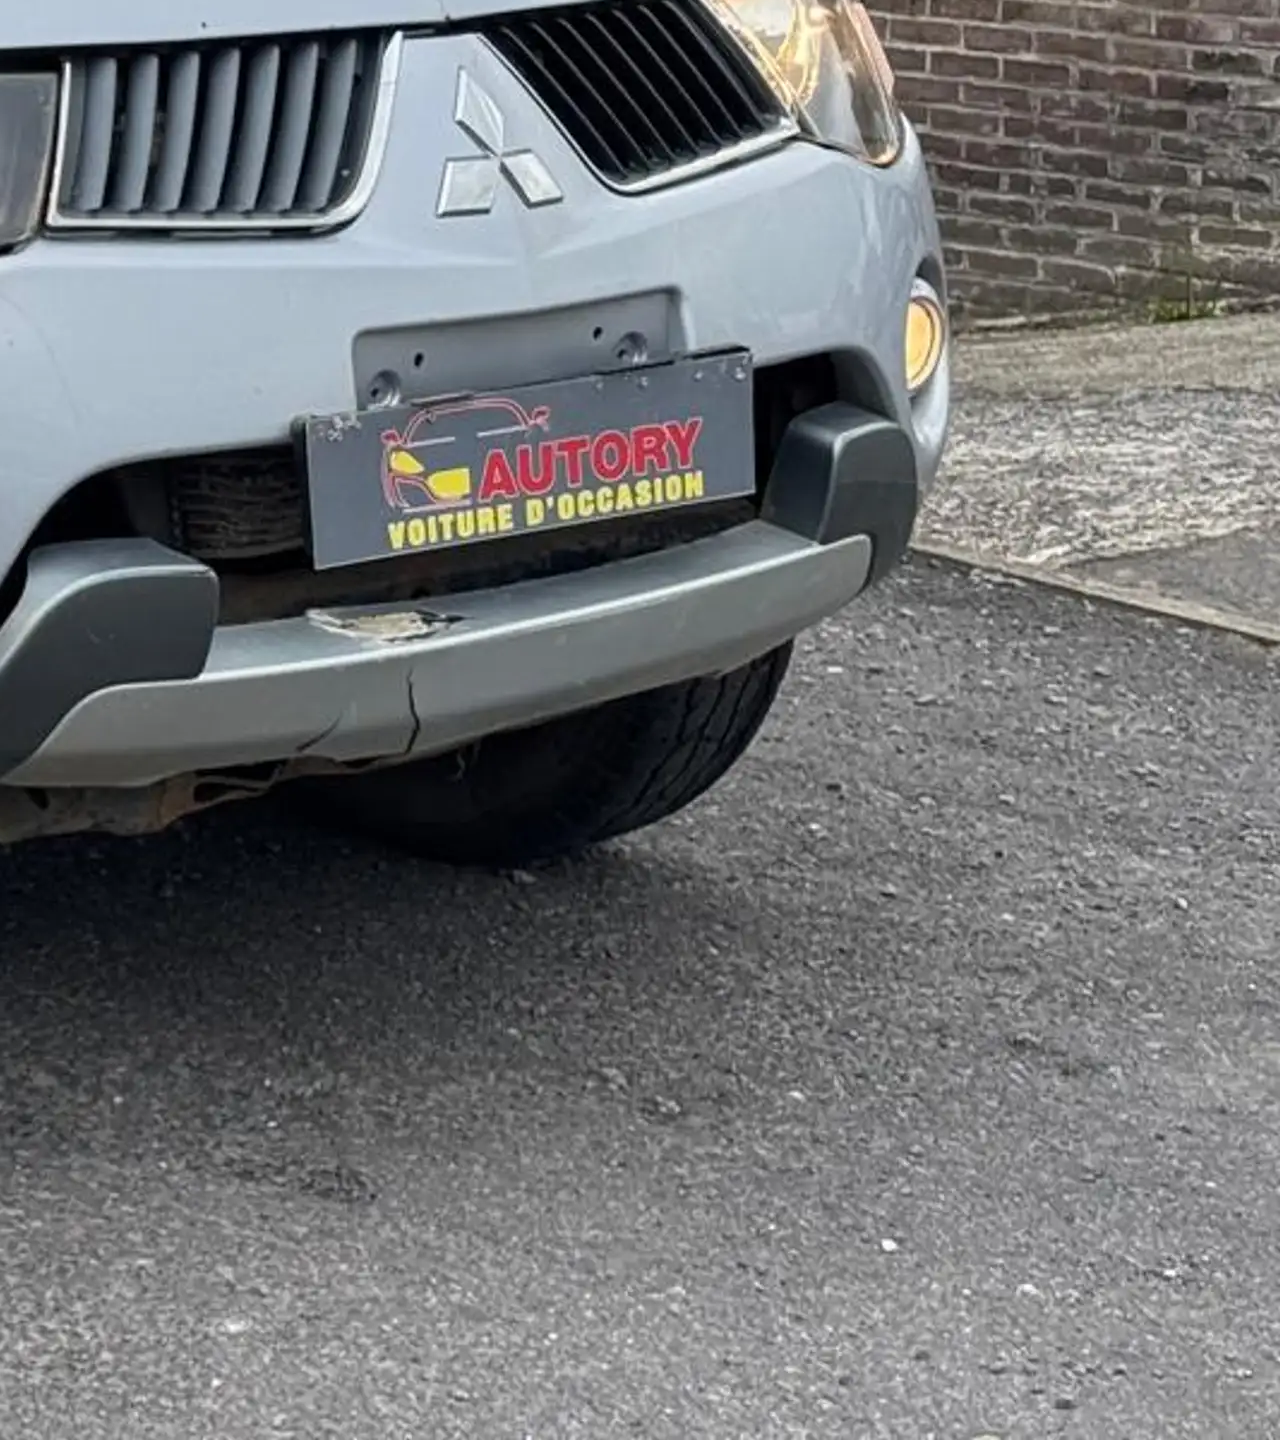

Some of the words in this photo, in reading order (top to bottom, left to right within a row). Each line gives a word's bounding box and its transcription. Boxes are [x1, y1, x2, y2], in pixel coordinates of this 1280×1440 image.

[477, 416, 703, 502] AUTORY
[388, 503, 514, 550] VOITURE
[525, 470, 705, 526] D'OCCASION
